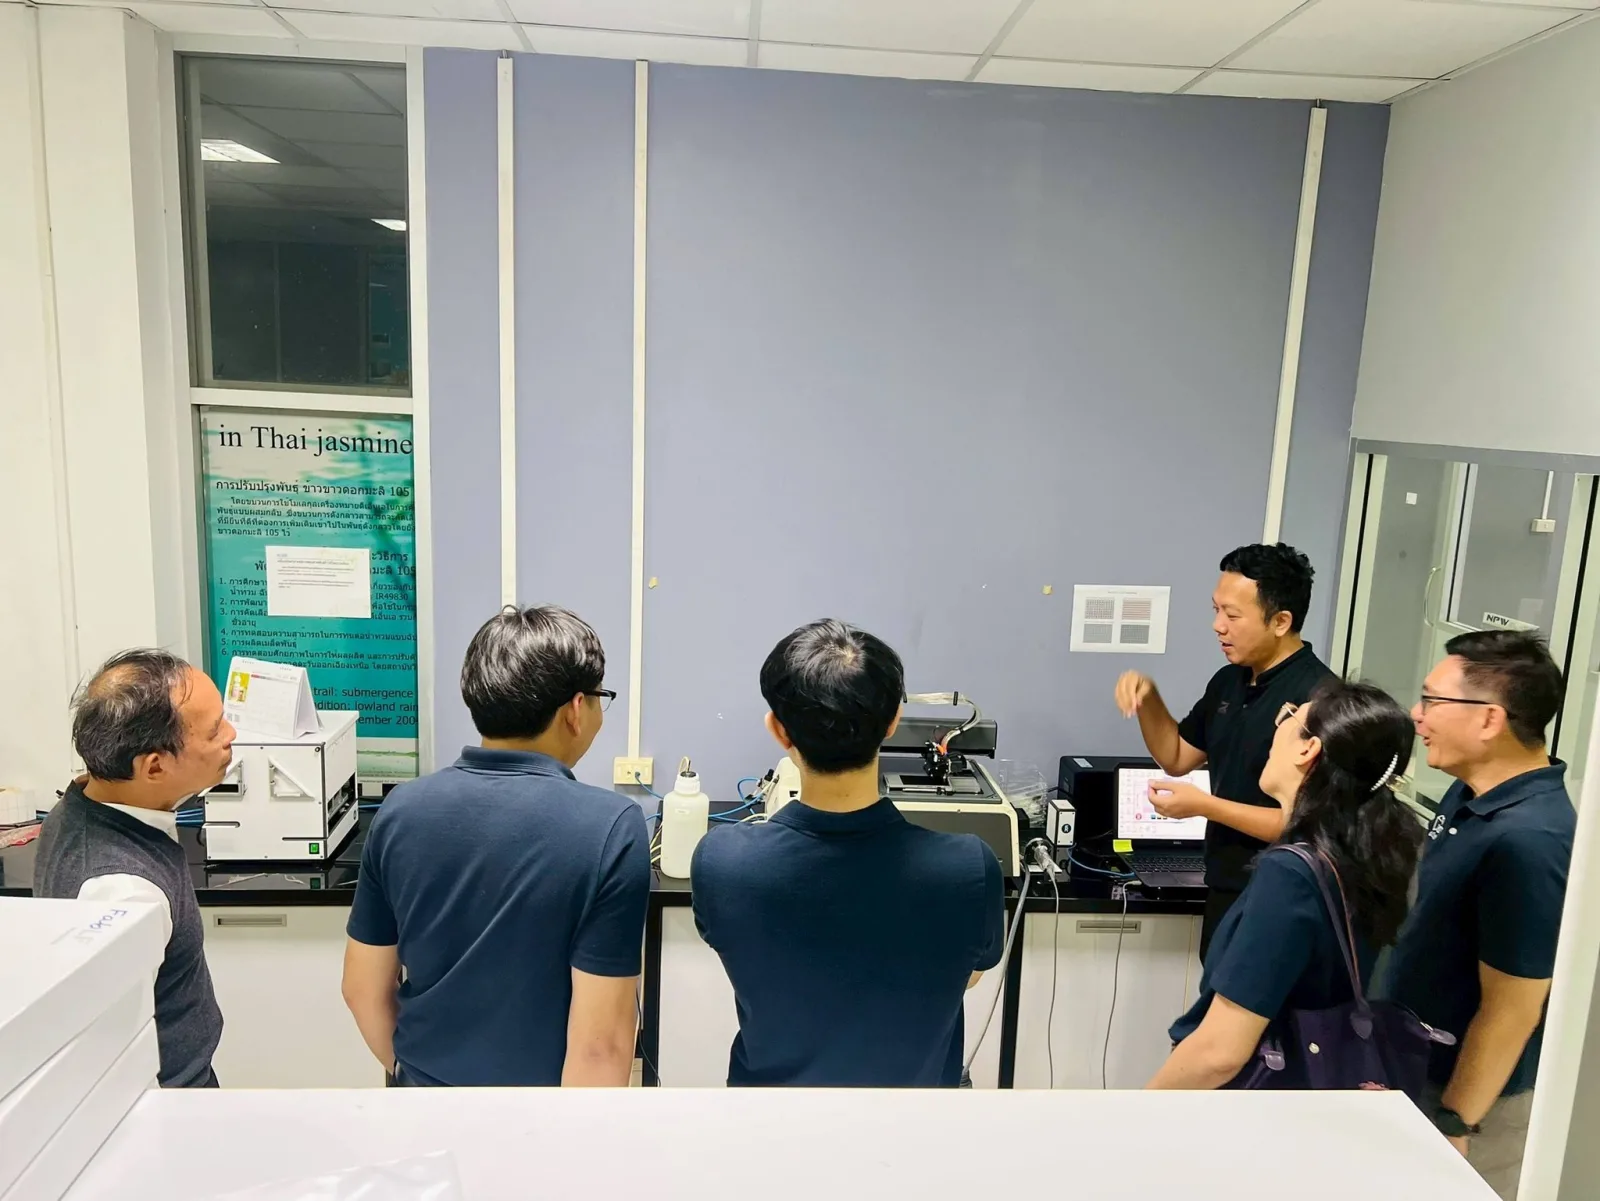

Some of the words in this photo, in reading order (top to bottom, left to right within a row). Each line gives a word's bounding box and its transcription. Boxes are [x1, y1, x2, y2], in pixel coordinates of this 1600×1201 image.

[219, 424, 243, 448] in
[250, 426, 307, 450] Thai
[313, 428, 413, 457] jasmine
[390, 486, 410, 497] 105
[265, 528, 280, 537] 105
[219, 598, 228, 606] 2.
[220, 608, 228, 616] 3.
[1486, 614, 1510, 627] NPW
[221, 628, 228, 636] 4.
[221, 638, 229, 646] 5.
[221, 648, 229, 656] 6.
[313, 687, 337, 697] trail:
[341, 687, 413, 700] submergence
[355, 702, 396, 712] lowland
